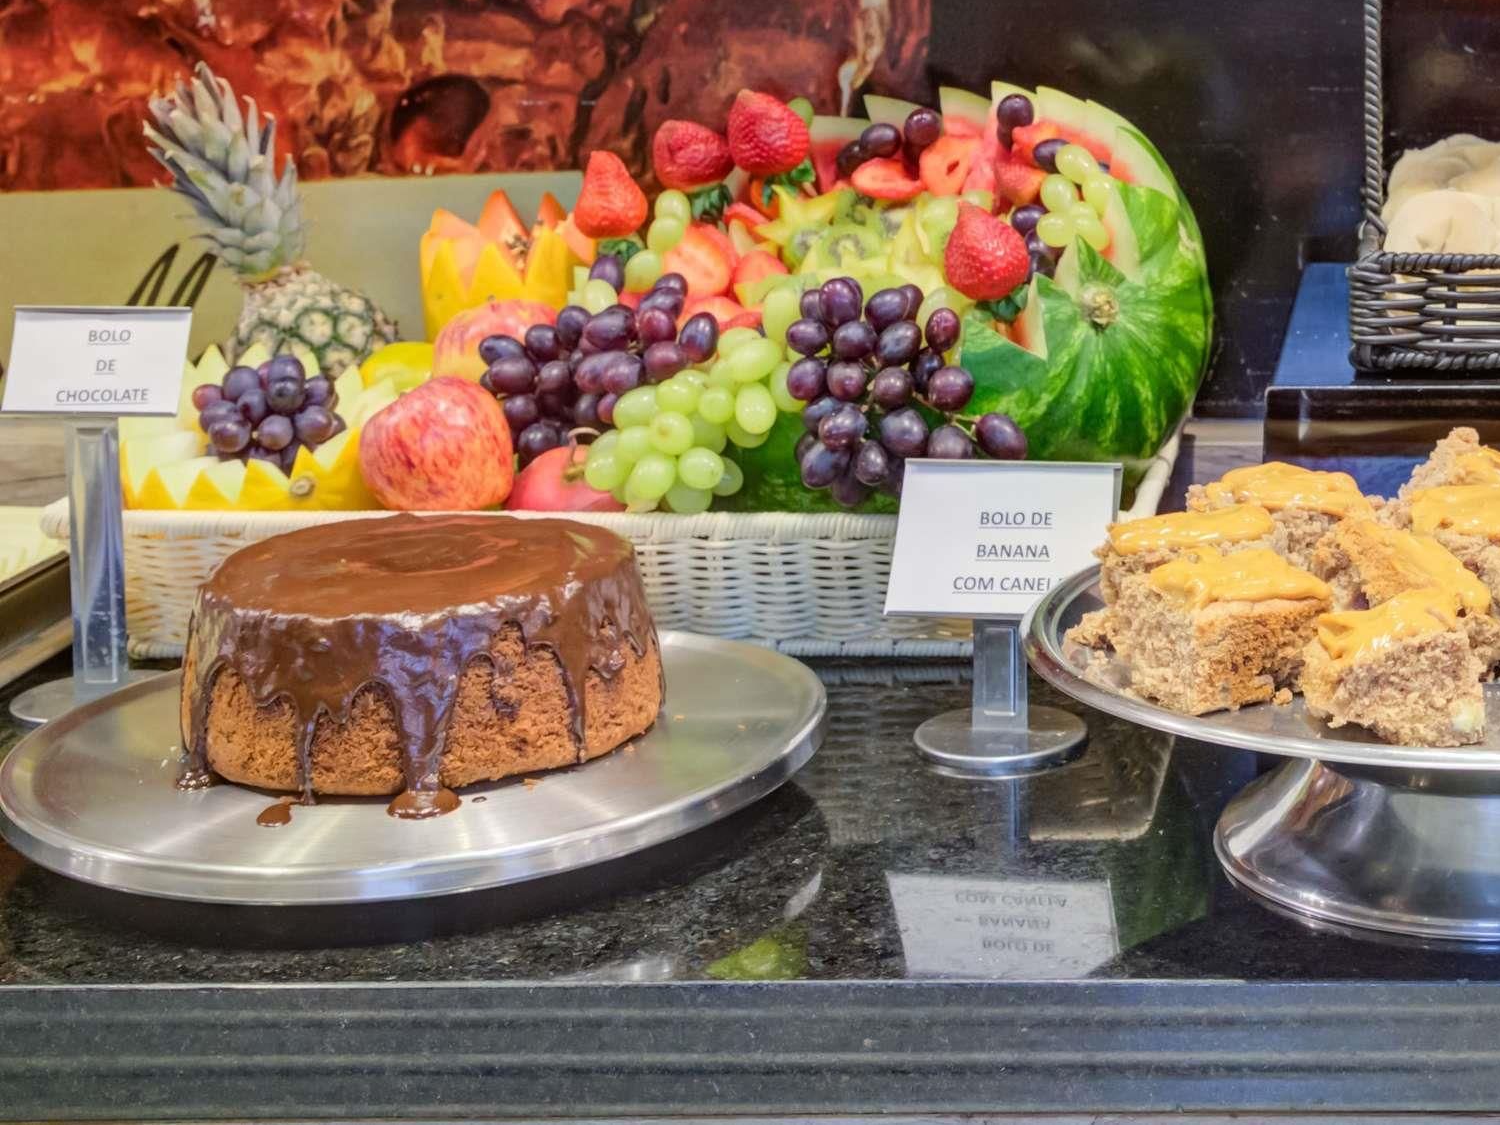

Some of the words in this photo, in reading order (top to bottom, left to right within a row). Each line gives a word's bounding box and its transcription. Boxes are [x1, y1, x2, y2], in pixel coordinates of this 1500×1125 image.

[88, 329, 131, 343] BOLO
[96, 359, 117, 372] DE
[56, 388, 149, 403] CHOCOLATE
[980, 511, 1025, 525] BOLO
[1031, 512, 1053, 526] DE
[976, 544, 1050, 559] BANANA
[953, 576, 994, 591] COM
